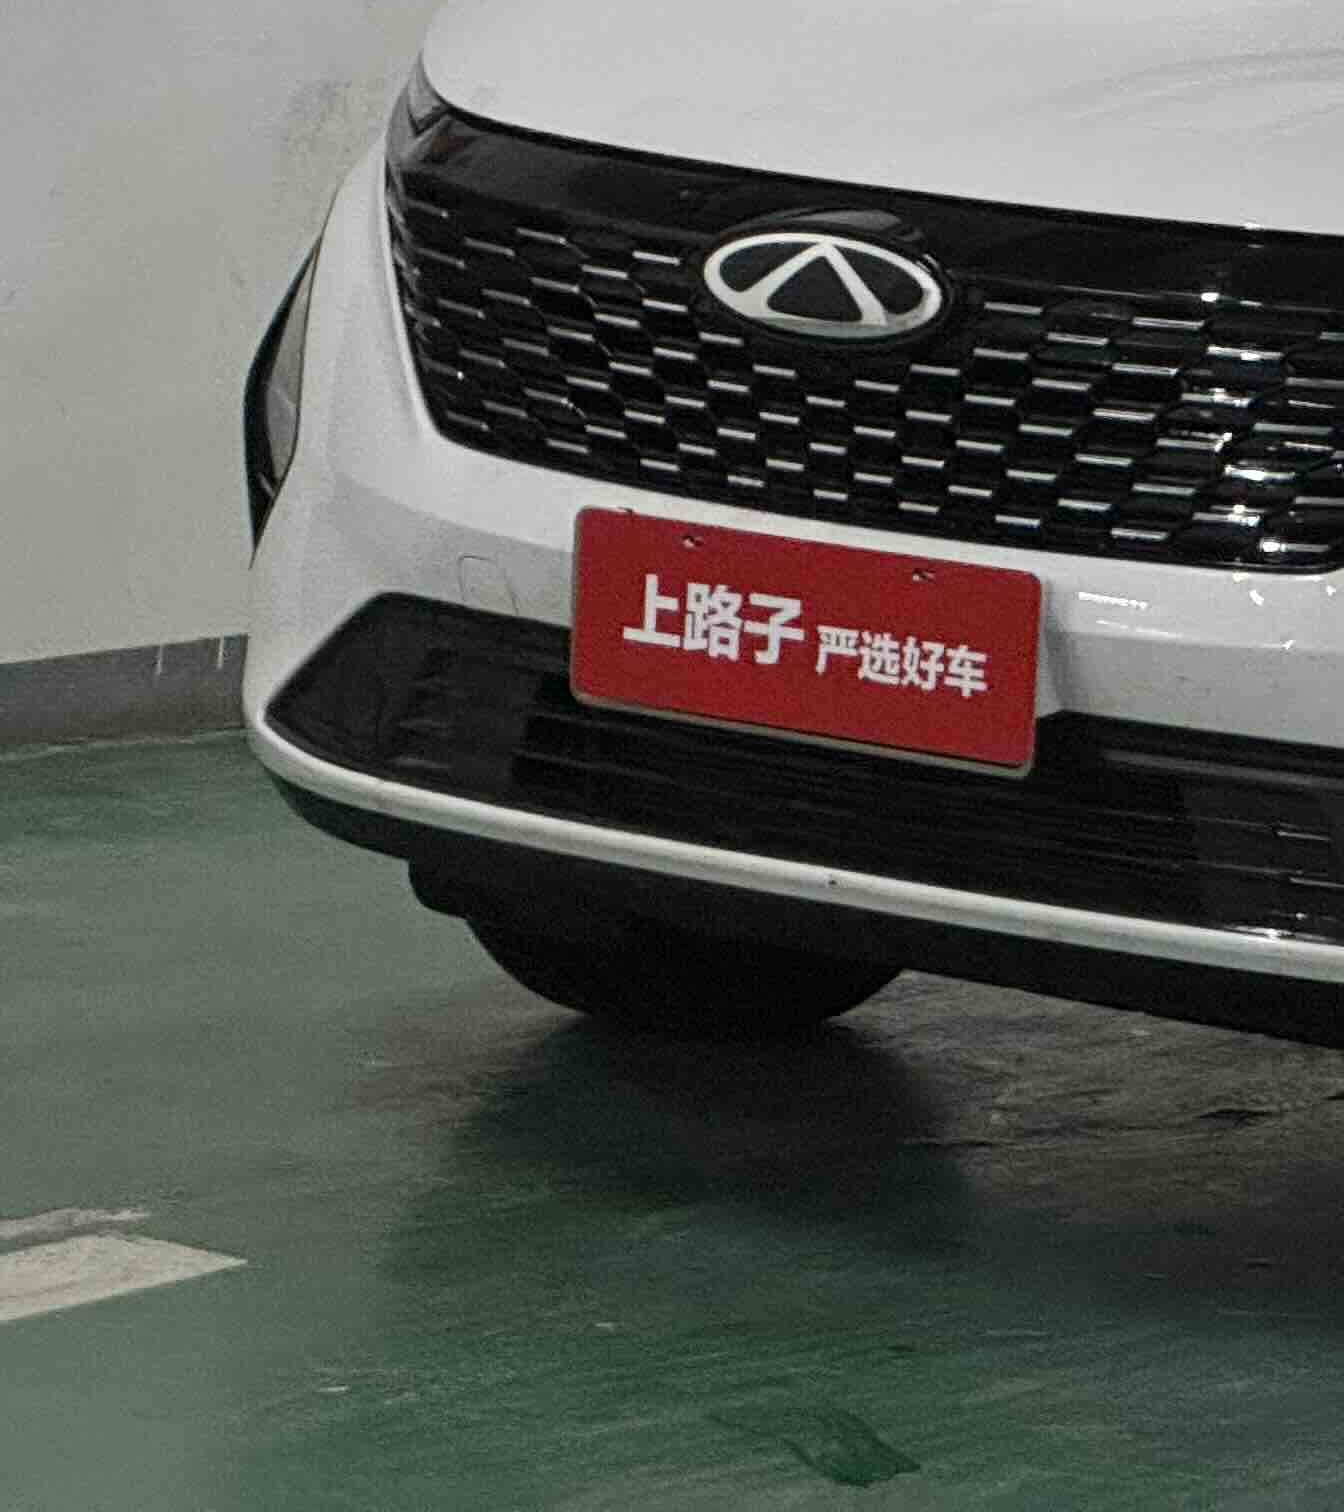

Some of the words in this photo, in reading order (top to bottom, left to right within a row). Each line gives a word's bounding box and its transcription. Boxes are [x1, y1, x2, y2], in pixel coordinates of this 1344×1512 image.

[622, 572, 806, 667] 上路子
[814, 624, 989, 699] 严选好车
